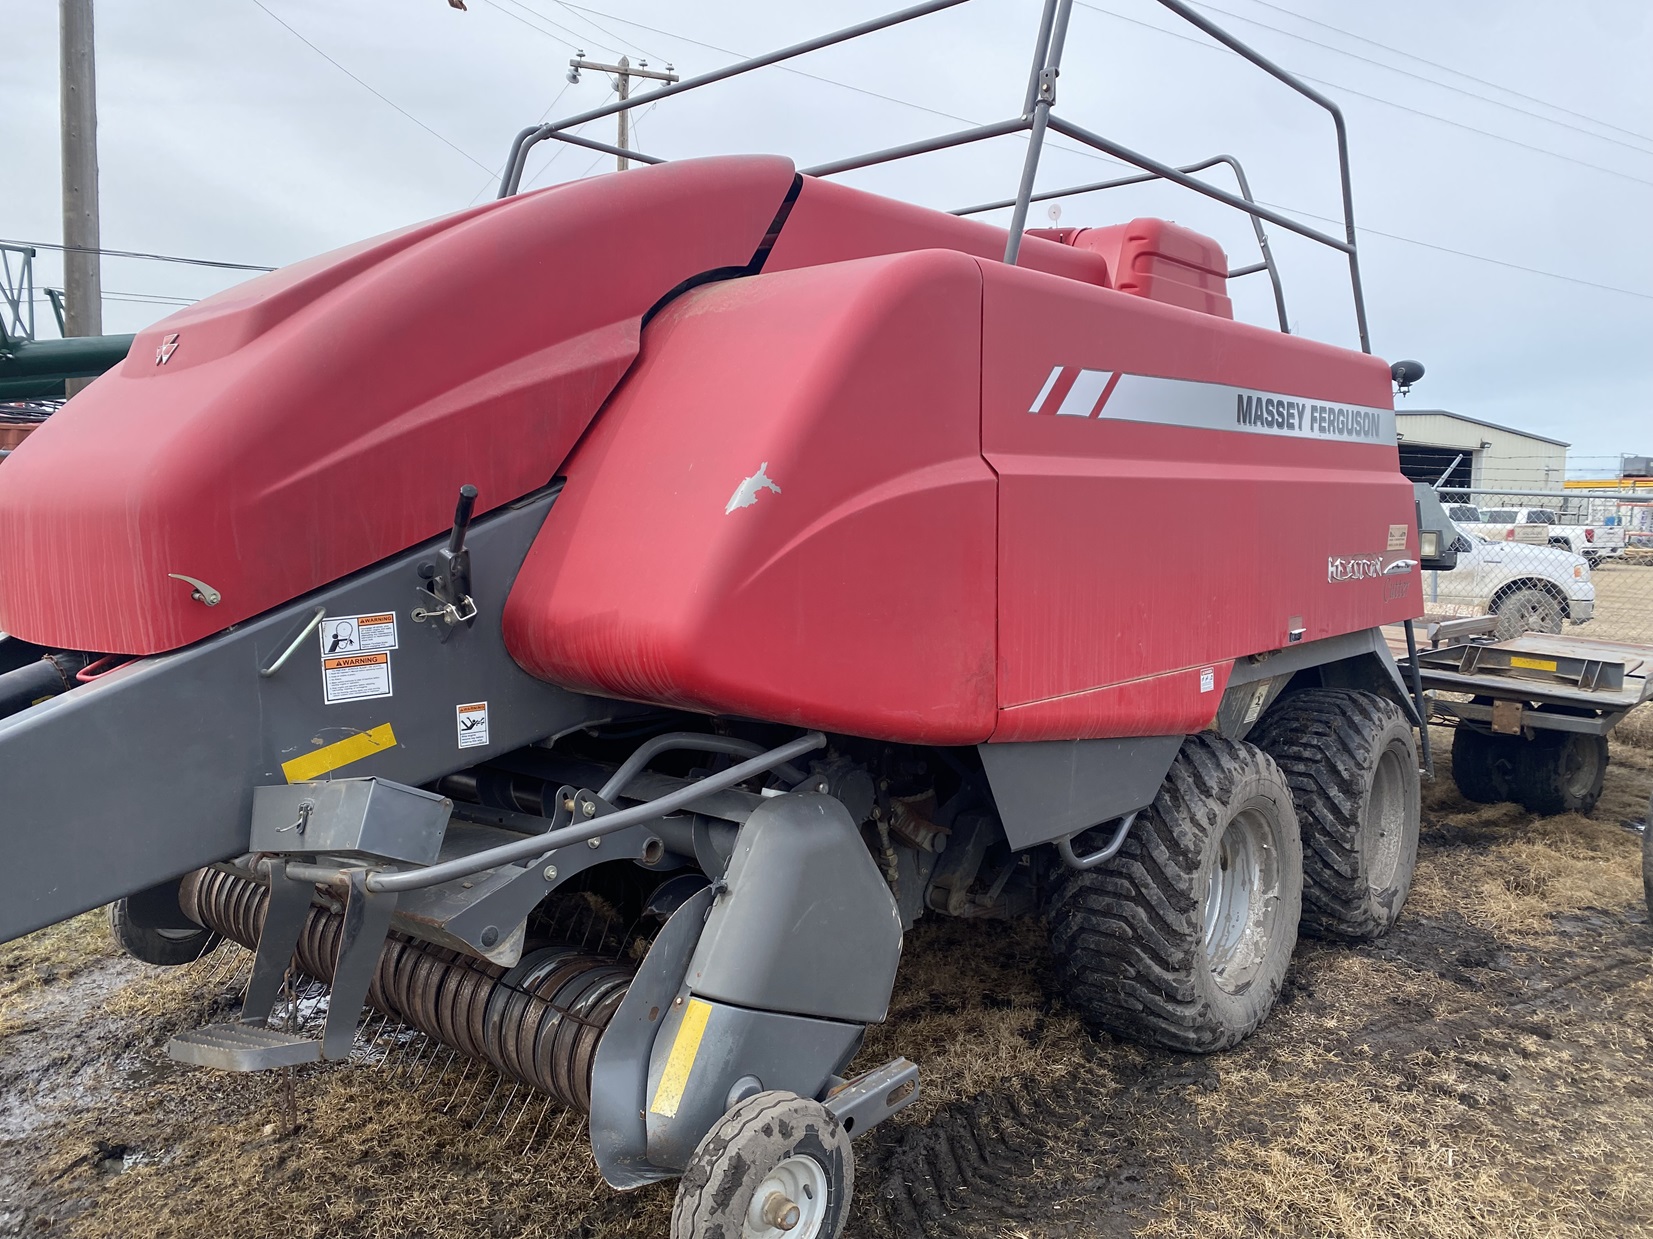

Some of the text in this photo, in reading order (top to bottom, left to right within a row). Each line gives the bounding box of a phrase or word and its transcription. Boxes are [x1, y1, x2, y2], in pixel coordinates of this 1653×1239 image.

[1236, 394, 1381, 438] MASSEY FERGUSON
[364, 616, 392, 624] WARNING
[342, 656, 378, 667] WARNING
